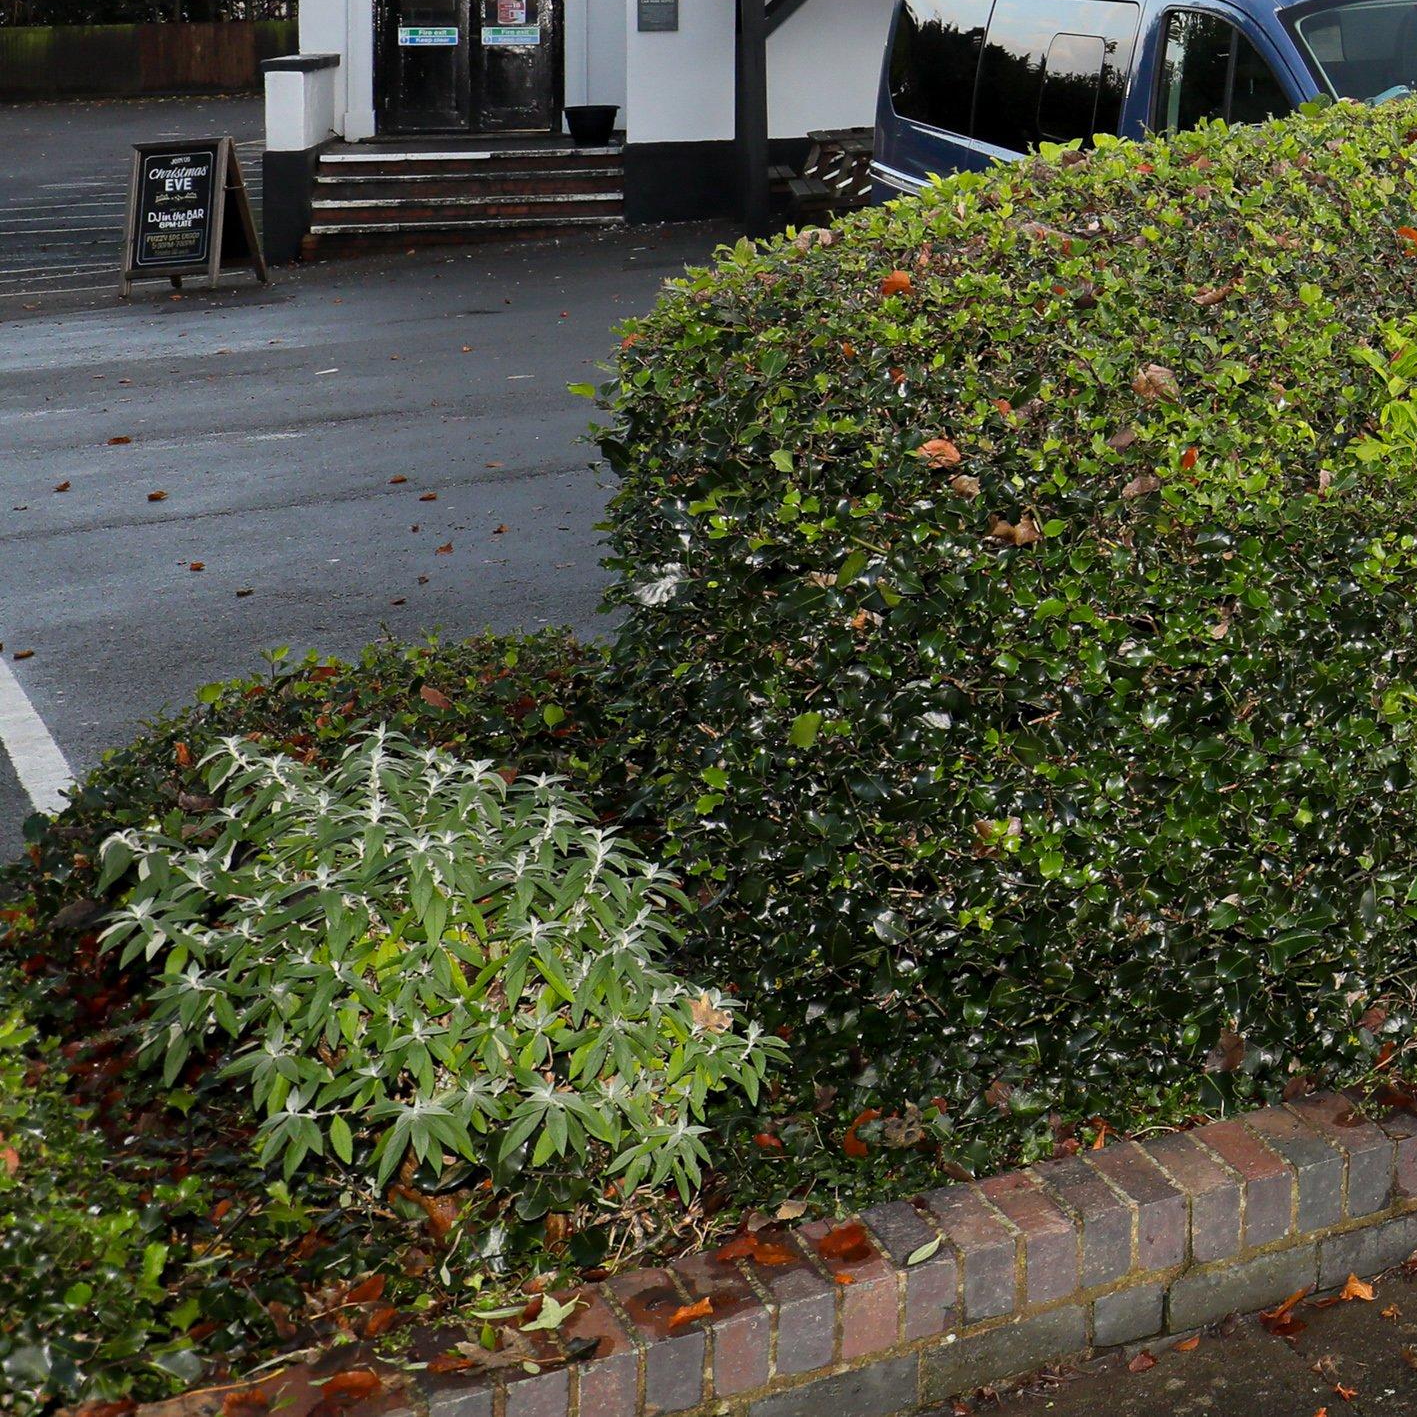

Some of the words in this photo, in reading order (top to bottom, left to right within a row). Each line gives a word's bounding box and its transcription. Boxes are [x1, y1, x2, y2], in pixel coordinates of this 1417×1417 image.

[149, 166, 207, 180] Christmas
[165, 178, 192, 192] EVE
[148, 212, 161, 223] DJ
[161, 212, 172, 221] in
[172, 211, 186, 220] the
[186, 208, 204, 219] BAR
